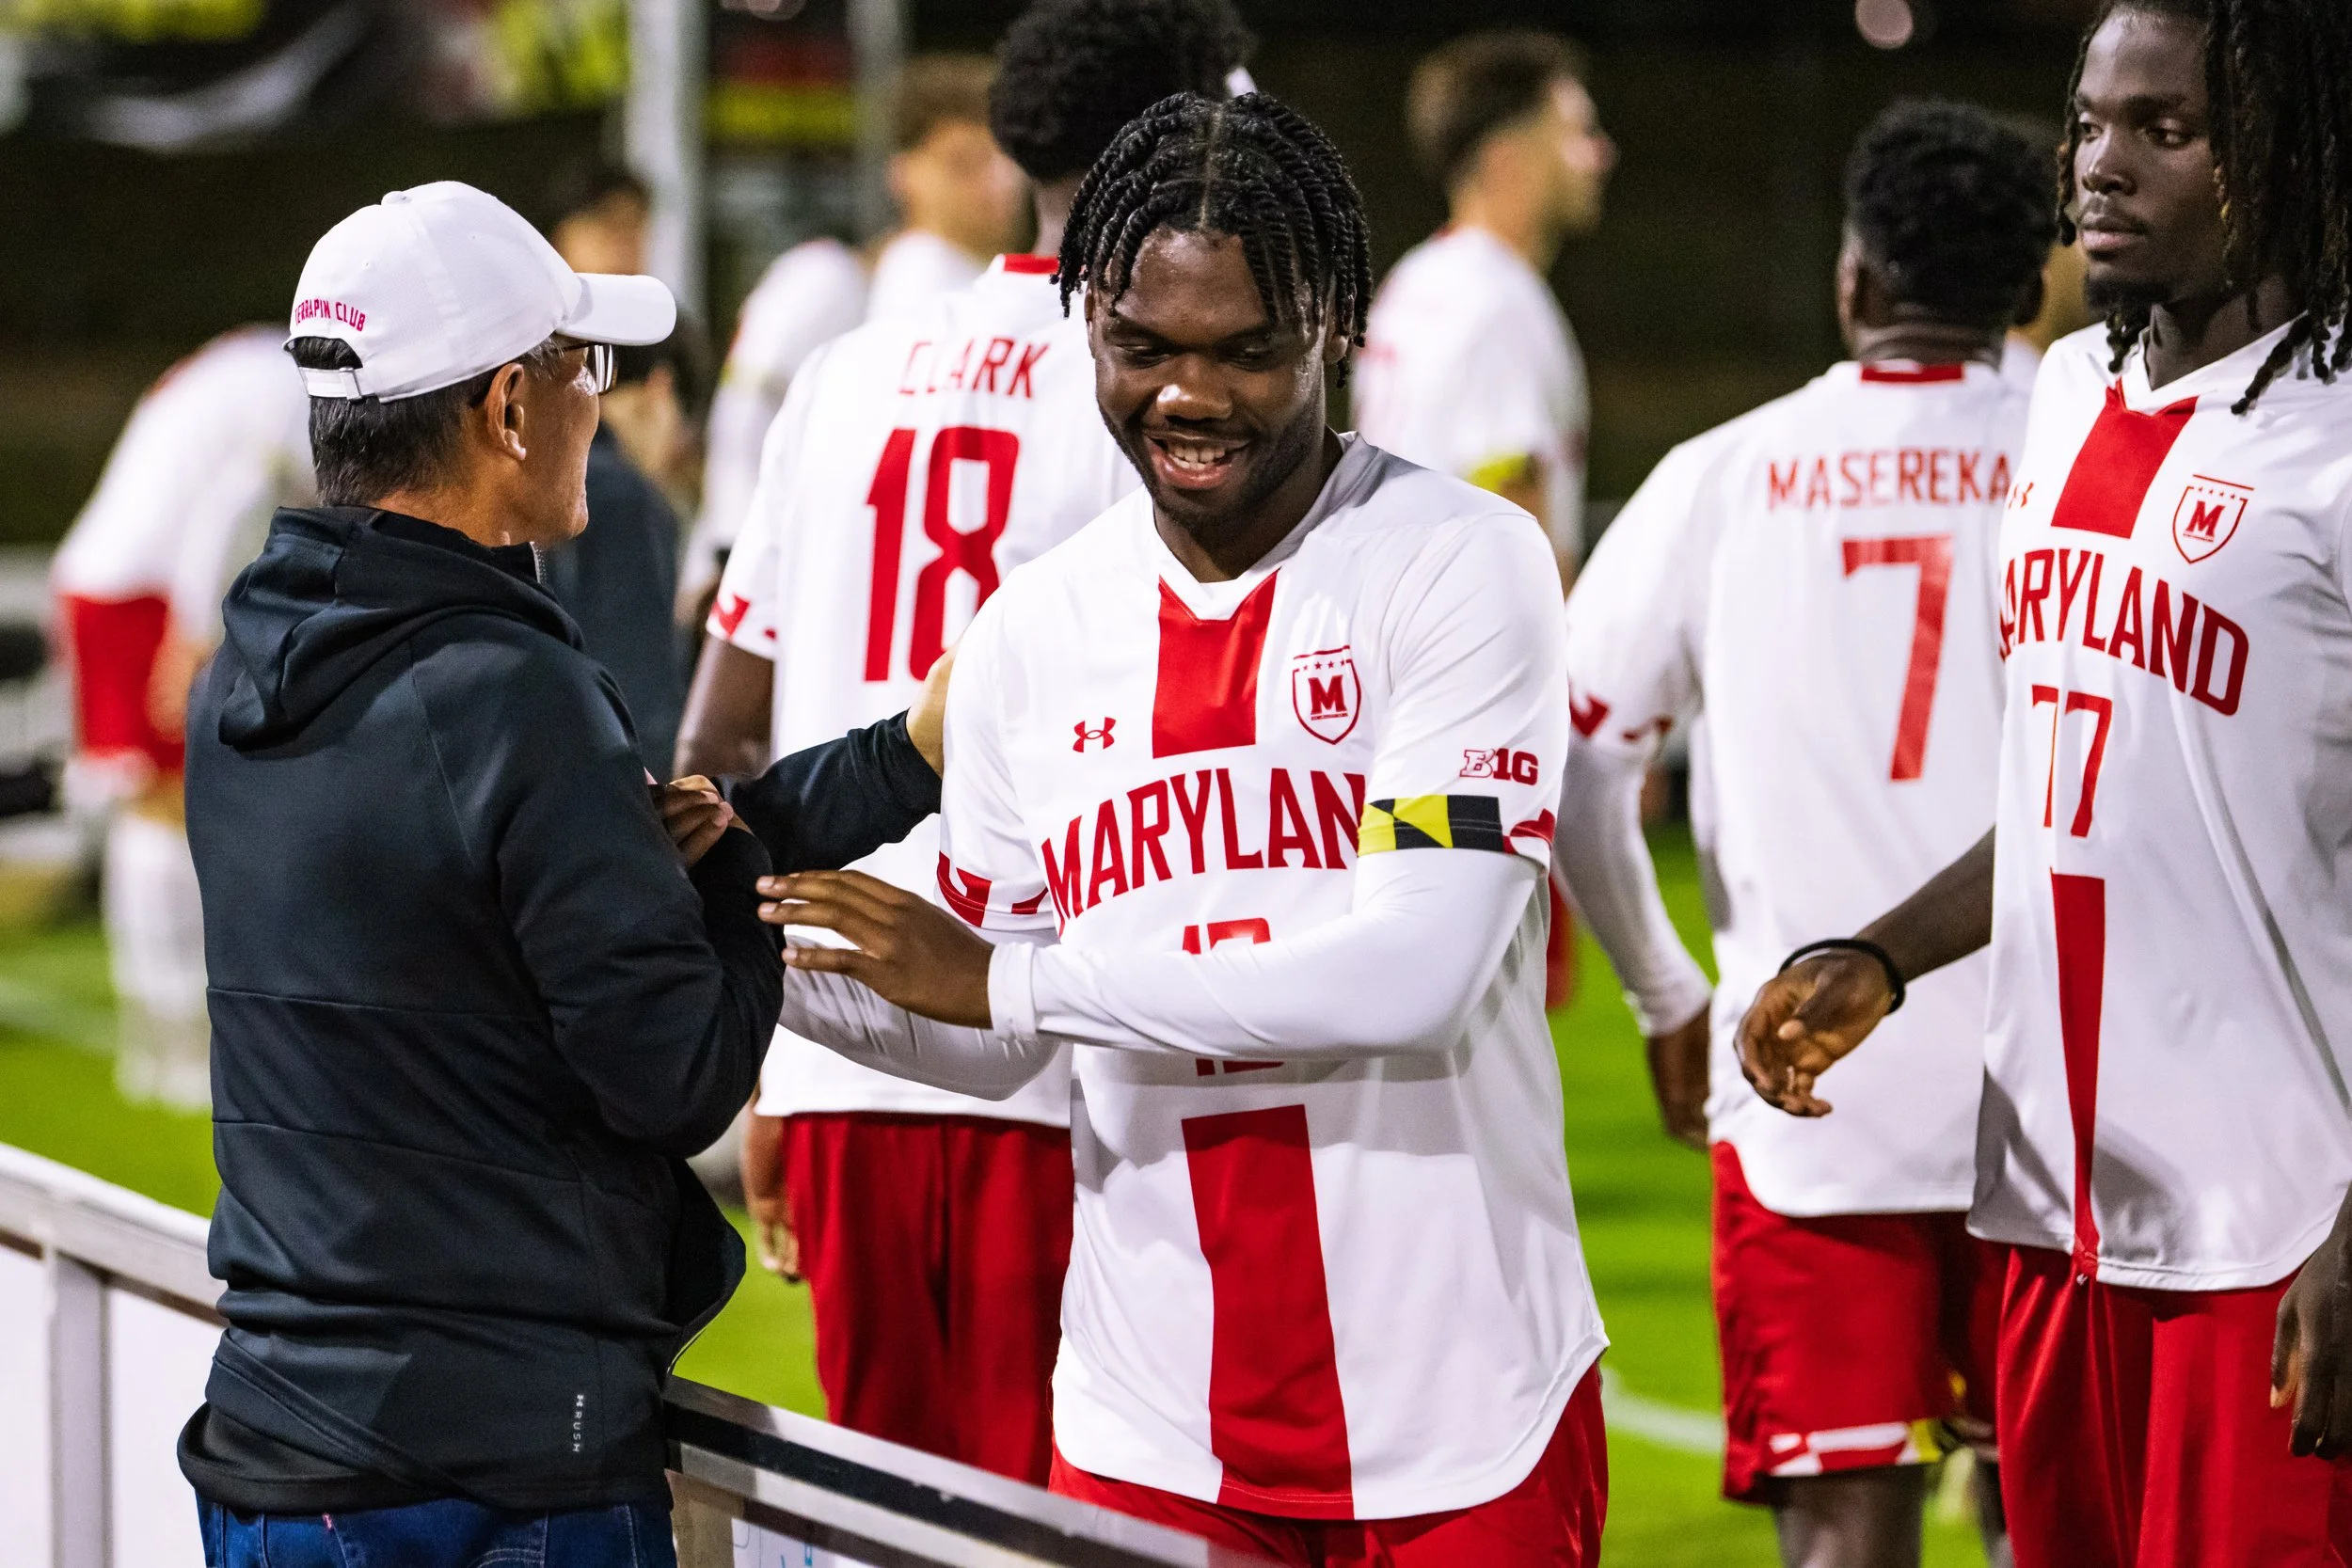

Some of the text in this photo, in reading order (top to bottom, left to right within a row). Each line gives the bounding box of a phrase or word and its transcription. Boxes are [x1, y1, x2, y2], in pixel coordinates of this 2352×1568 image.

[294, 298, 366, 332] TERRAPIN CLUB
[898, 337, 1051, 399] CLARK
[1768, 447, 2011, 514] MASEREKA
[2185, 500, 2226, 537] M
[864, 426, 1020, 683] 18
[1842, 534, 1953, 783] 7
[1999, 548, 2249, 717] ARYLAND
[1308, 674, 1348, 715] M
[2031, 684, 2113, 838] 77
[1041, 768, 1366, 939] MARYLAN
[572, 1410, 582, 1453] RUSH
